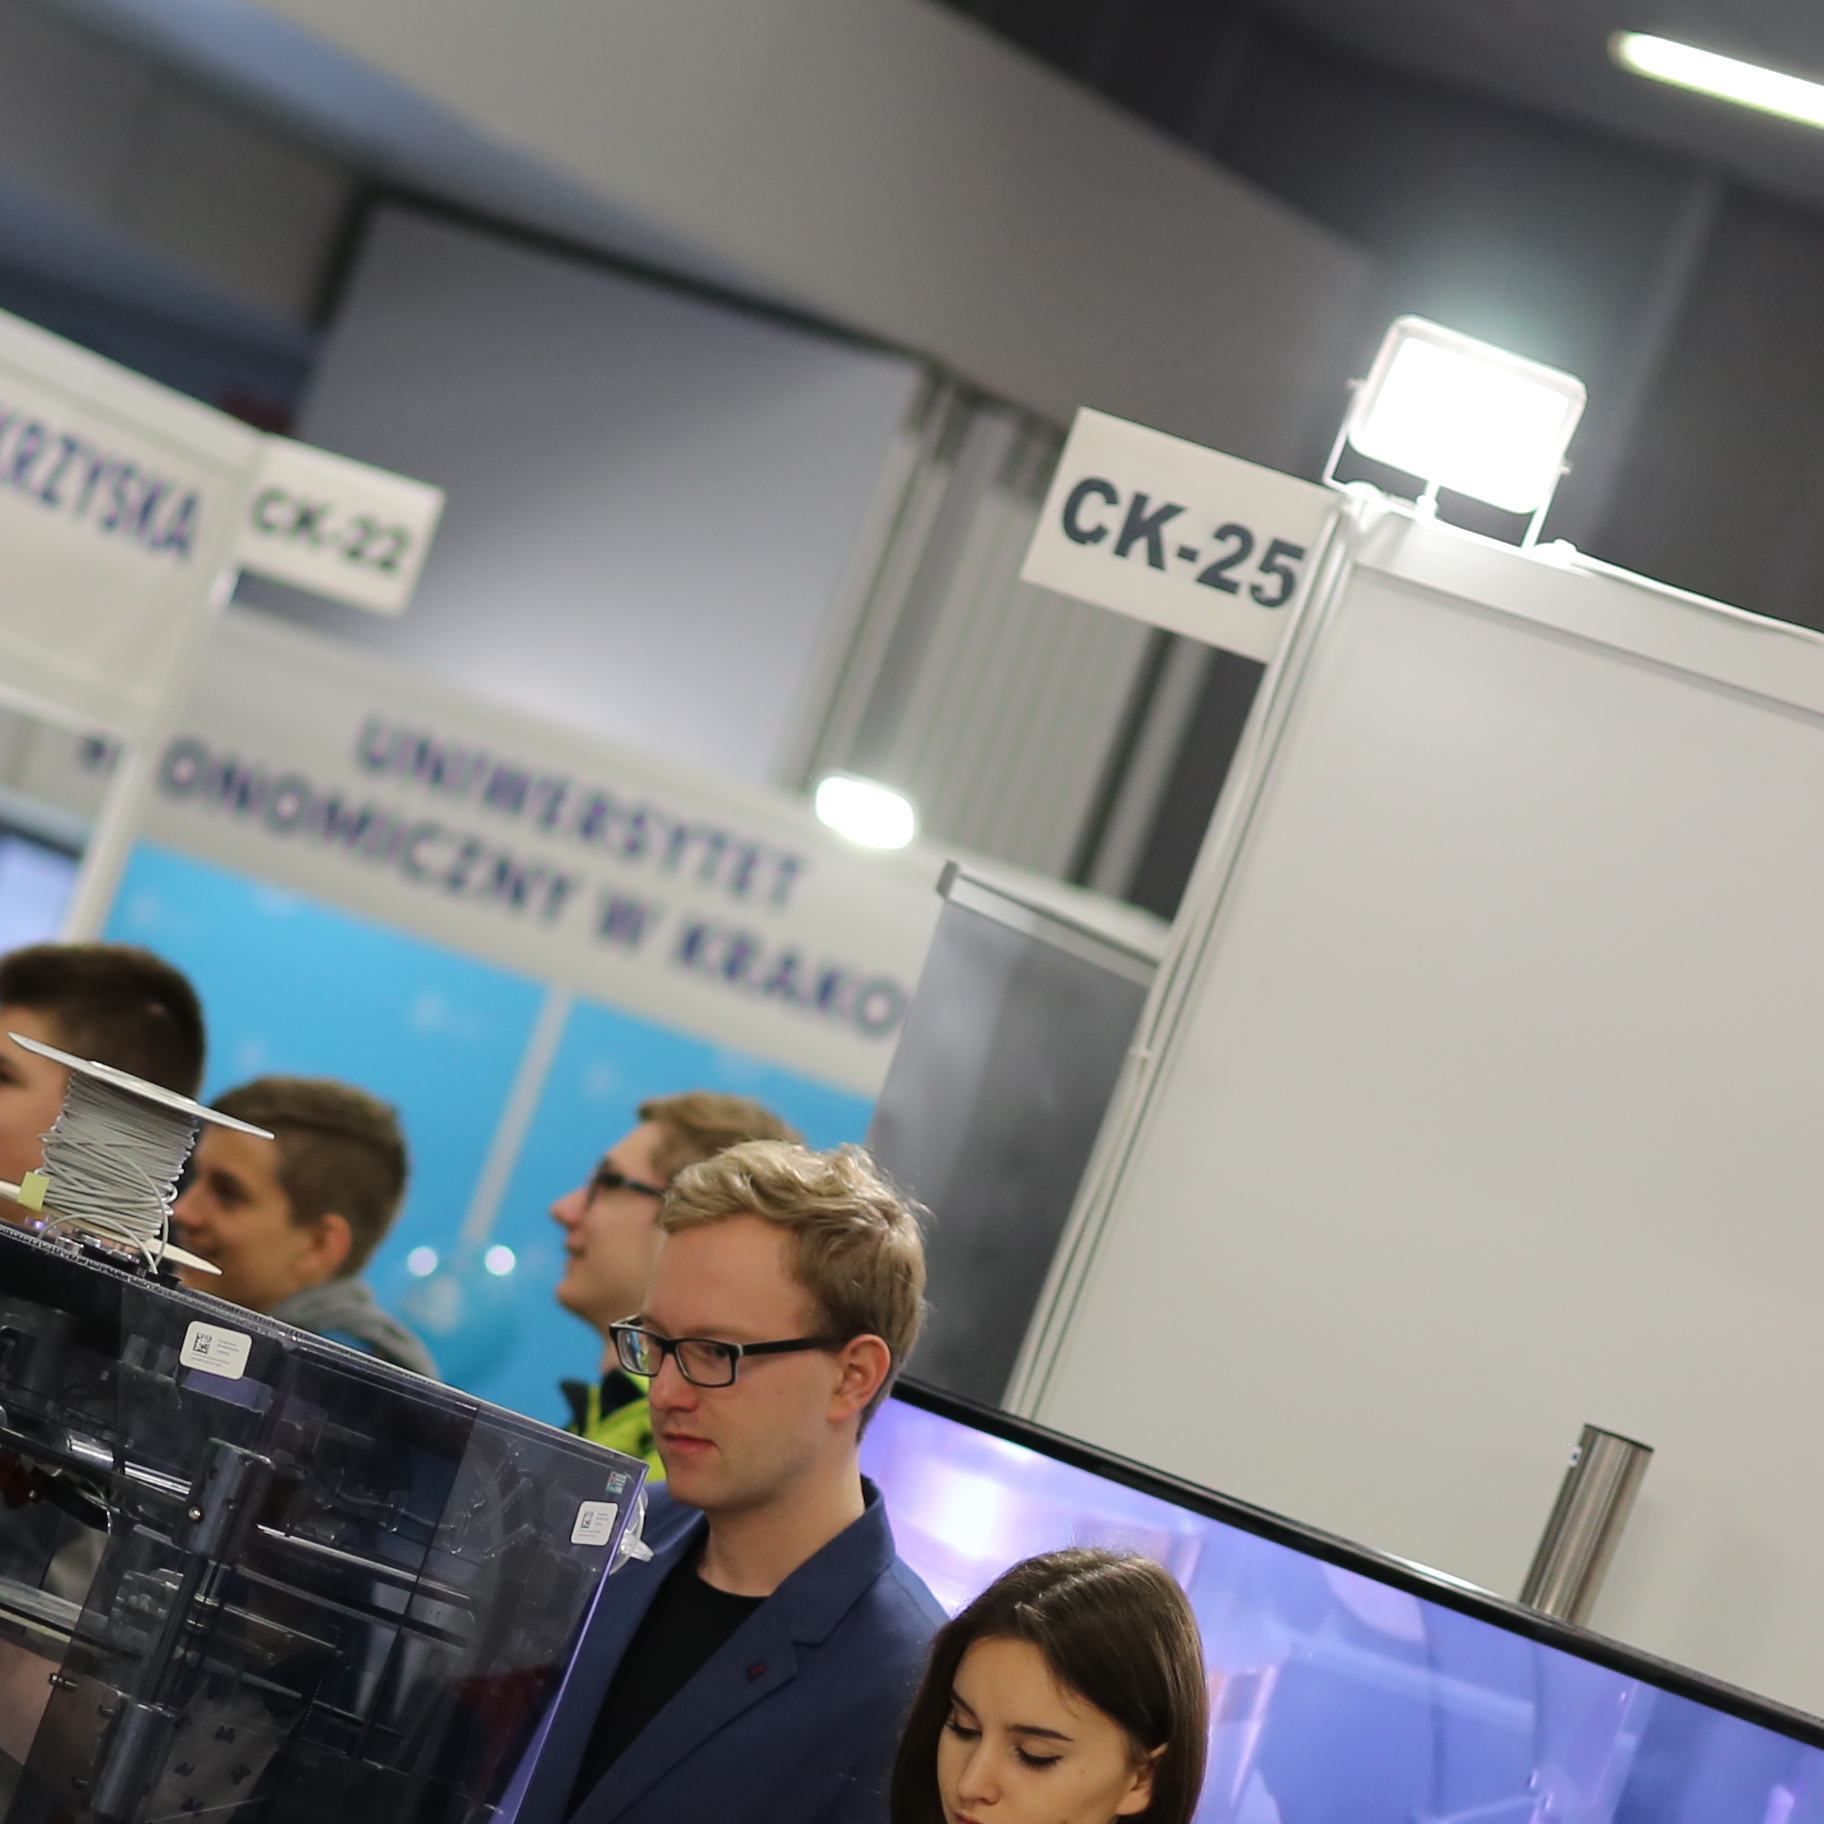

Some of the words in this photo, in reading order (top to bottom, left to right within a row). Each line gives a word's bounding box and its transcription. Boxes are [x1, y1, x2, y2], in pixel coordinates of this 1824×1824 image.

[251, 485, 413, 576] CK-22
[1061, 477, 1306, 610] CK-25
[157, 732, 581, 928] ONOMICZNY
[596, 890, 663, 951] W
[677, 916, 913, 1040] KRAKO
[354, 716, 812, 914] UNIWERSYTET
